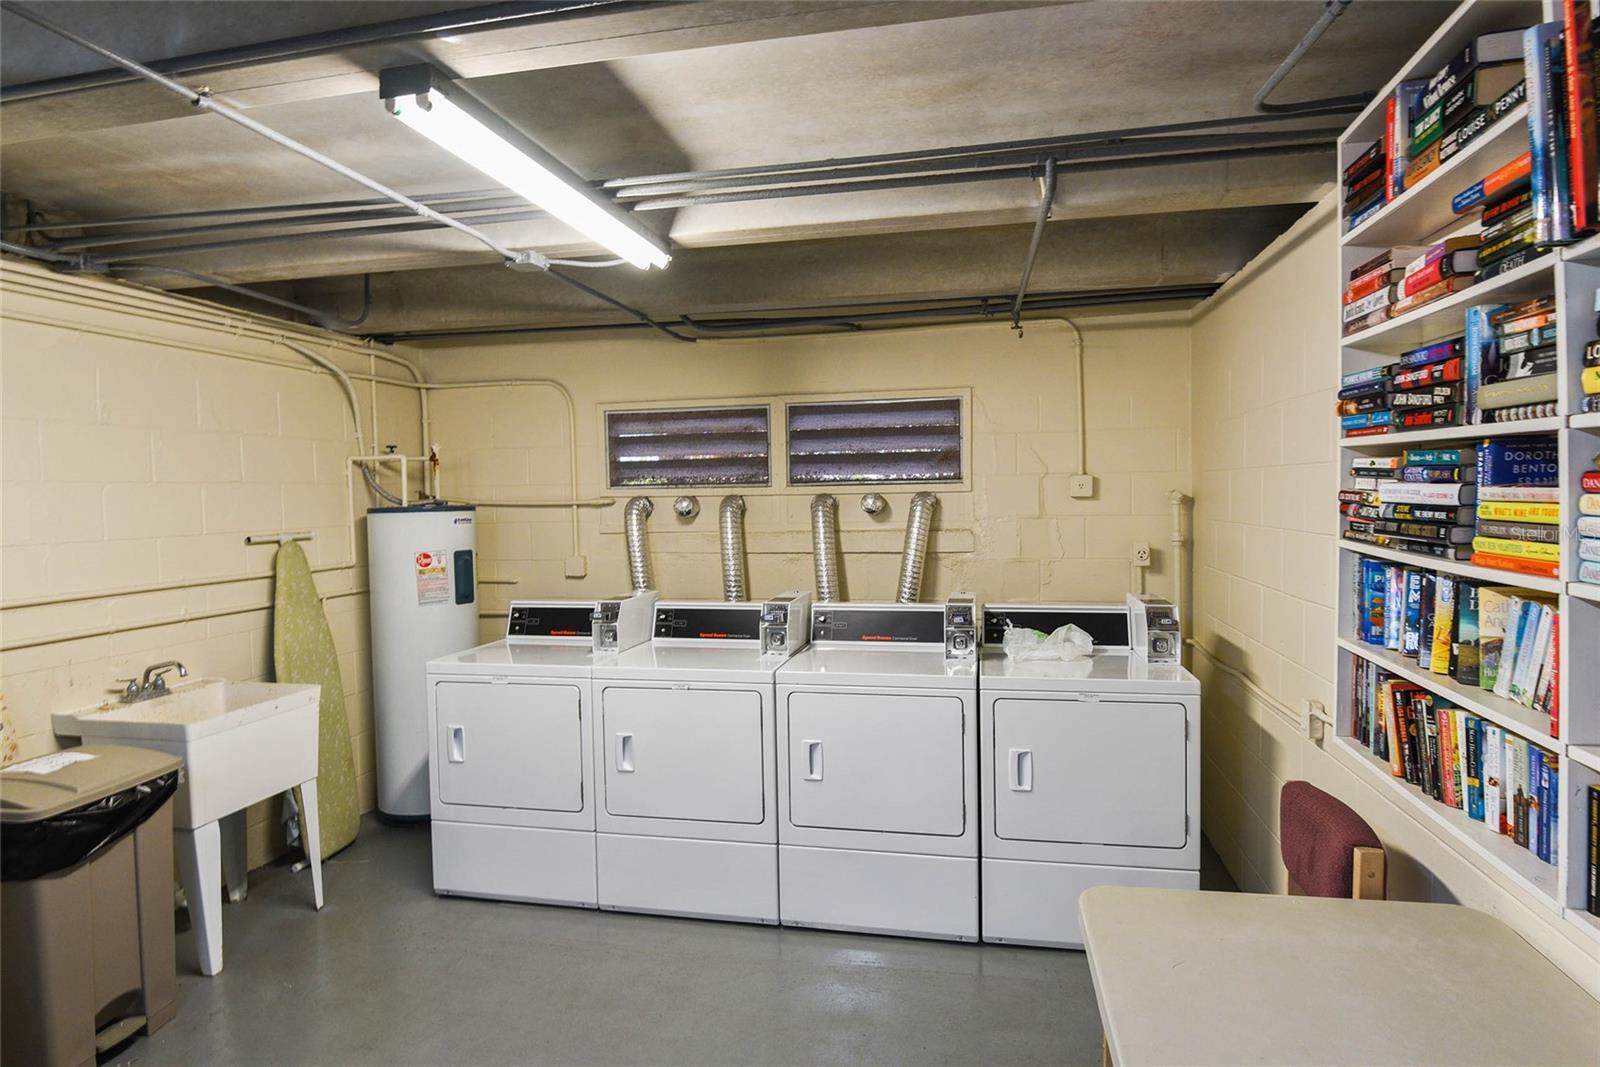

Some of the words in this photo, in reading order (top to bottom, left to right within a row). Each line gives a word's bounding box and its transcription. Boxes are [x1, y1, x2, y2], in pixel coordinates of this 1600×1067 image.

[1457, 114, 1486, 143] LOUISE
[1495, 81, 1526, 114] PENNY
[1407, 393, 1432, 406] SANDFORD
